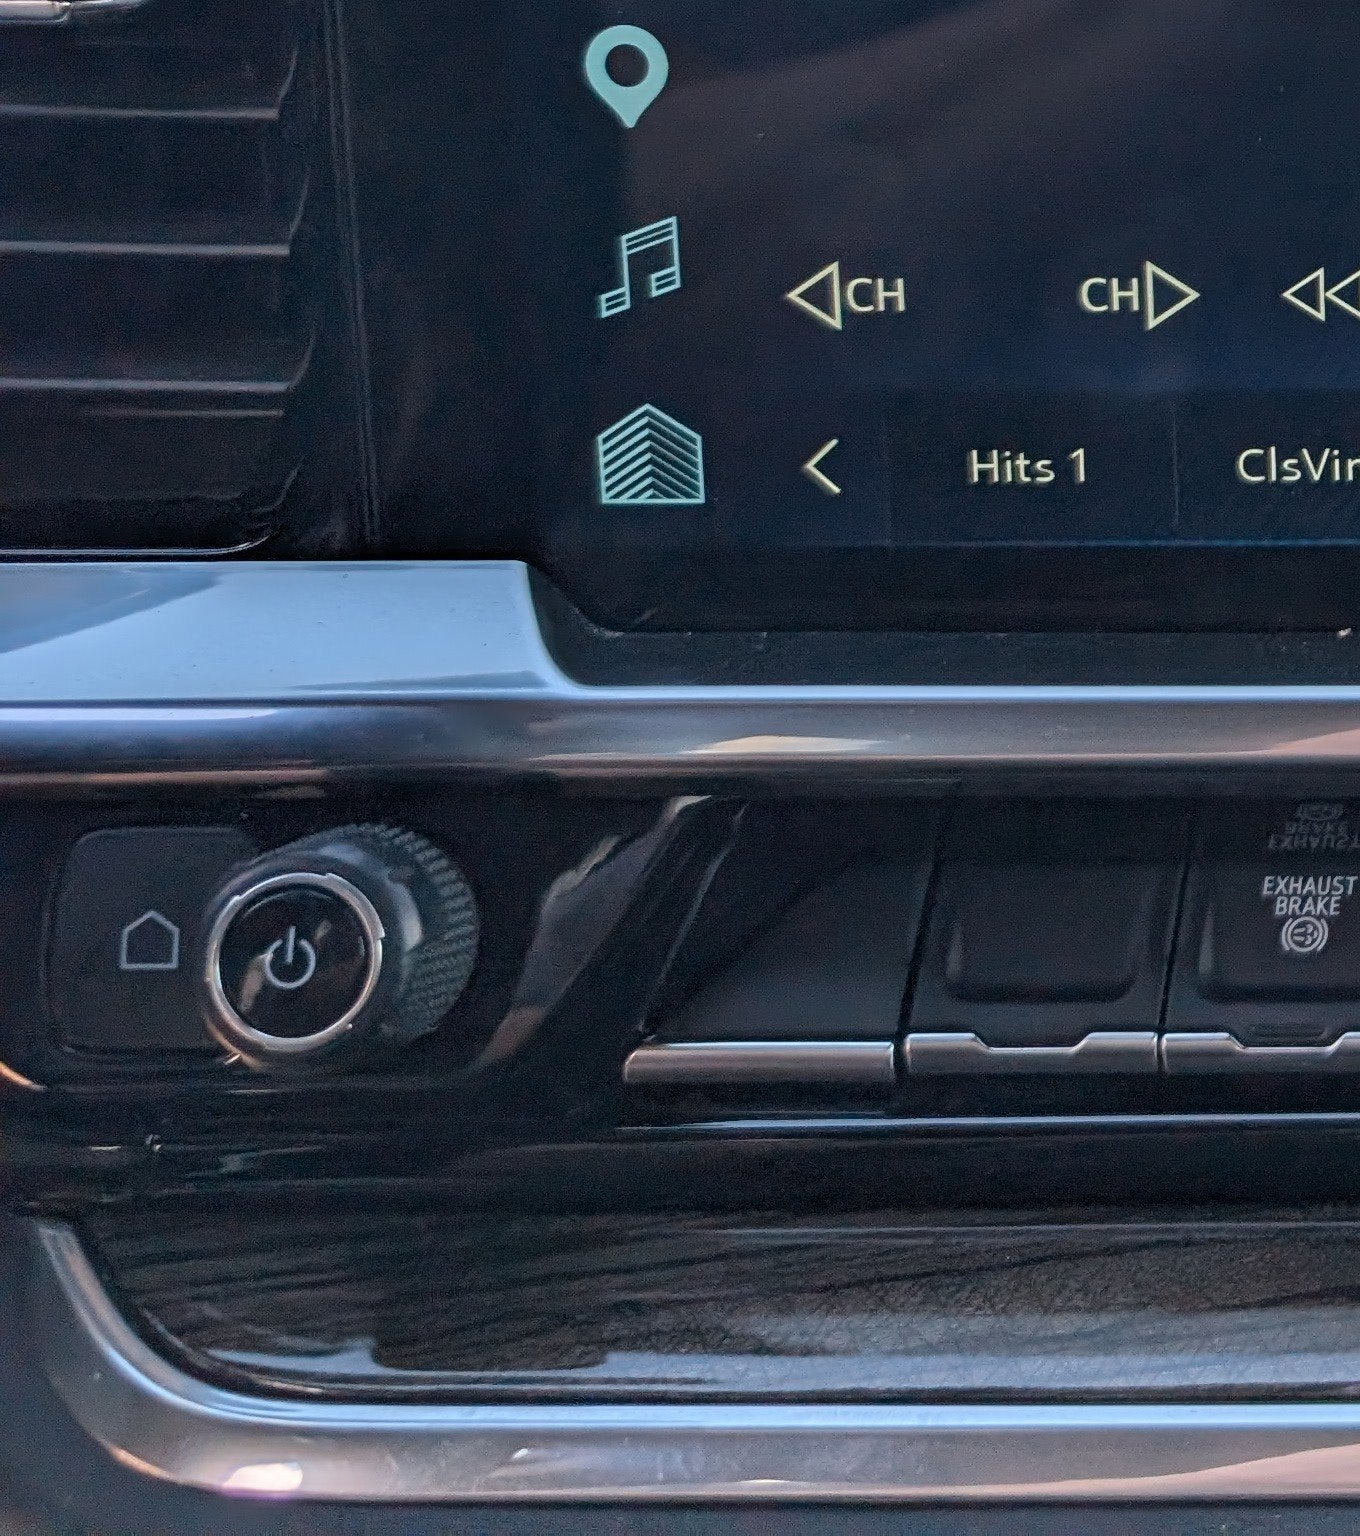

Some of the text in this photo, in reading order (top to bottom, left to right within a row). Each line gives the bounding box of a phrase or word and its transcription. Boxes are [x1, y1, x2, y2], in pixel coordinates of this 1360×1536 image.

[845, 277, 907, 313] CH
[1079, 277, 1140, 313] CH
[970, 447, 1087, 484] Hits 1
[1262, 875, 1360, 896] EXHAUST
[1274, 895, 1342, 916] BRAKE
